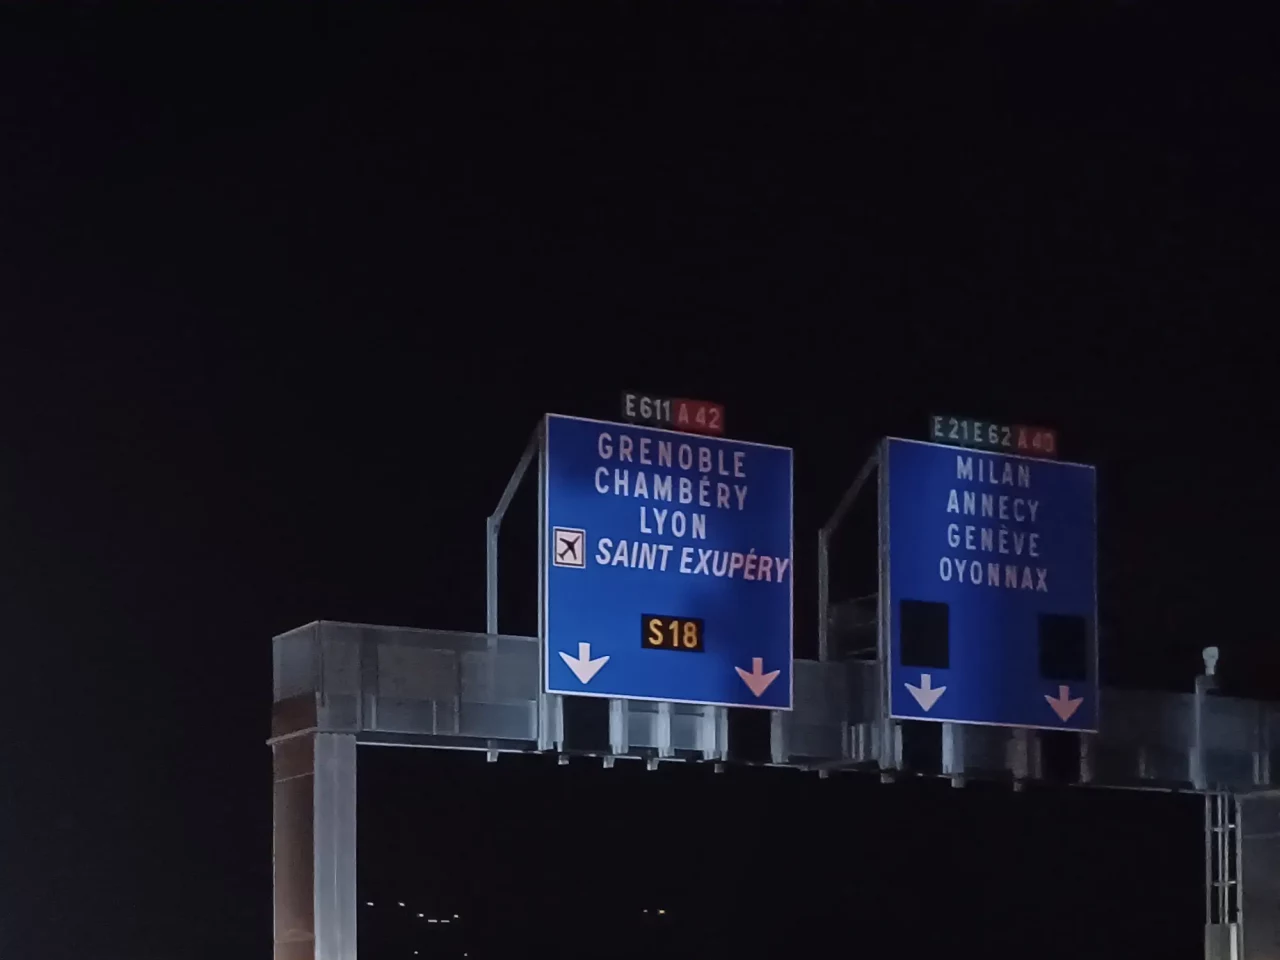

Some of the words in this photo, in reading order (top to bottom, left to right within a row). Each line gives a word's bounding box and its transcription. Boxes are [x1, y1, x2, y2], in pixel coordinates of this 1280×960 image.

[597, 431, 746, 478] GRENOBLE
[956, 455, 1030, 489] MILAN
[594, 466, 748, 511] CHAMBÉRY
[946, 488, 1039, 523] ANNECY
[639, 506, 706, 540] LYON
[947, 523, 1040, 557] GENÈVE
[595, 537, 673, 572] SAINT
[679, 547, 789, 583] EXUPÉRY
[939, 556, 1049, 593] OYONNAX
